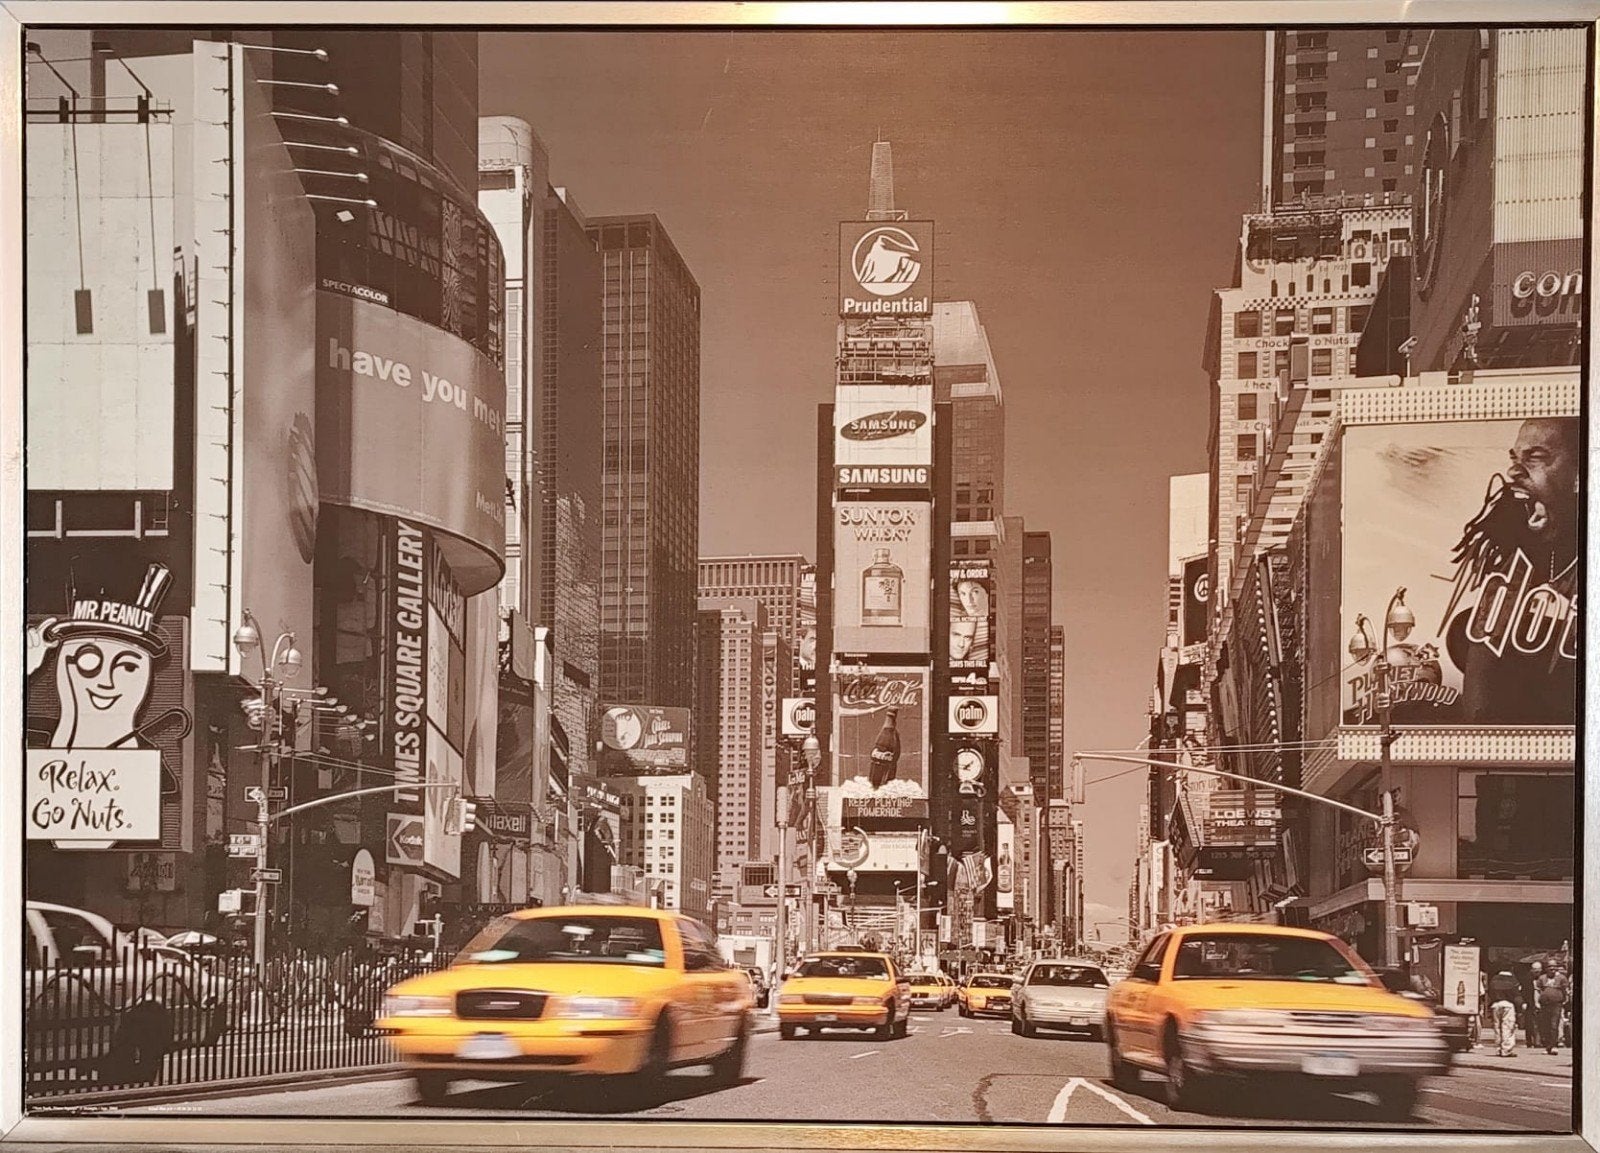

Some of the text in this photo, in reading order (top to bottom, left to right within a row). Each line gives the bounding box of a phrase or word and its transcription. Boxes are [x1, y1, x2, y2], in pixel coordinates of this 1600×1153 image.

[322, 278, 389, 304] SPECTACOLOR
[844, 297, 928, 313] Prudential
[329, 337, 412, 388] have
[421, 370, 467, 411] you
[849, 418, 918, 433] SAMSUNG
[839, 467, 928, 484] SAMSUNG
[855, 528, 912, 542] WHISKY
[73, 600, 154, 632] MR. PEANUT
[393, 520, 424, 803] TIMES SQUARE GALLERY
[843, 678, 922, 706] Coca-Cola
[1347, 664, 1423, 708] PLNET
[959, 705, 982, 724] palm
[39, 760, 120, 793] Relax.
[848, 798, 870, 807] KEEP
[858, 807, 902, 817] POWERADE
[32, 797, 133, 832] Go Nuts.
[1214, 810, 1272, 819] LOEWS
[1215, 819, 1272, 827] THEATRES
